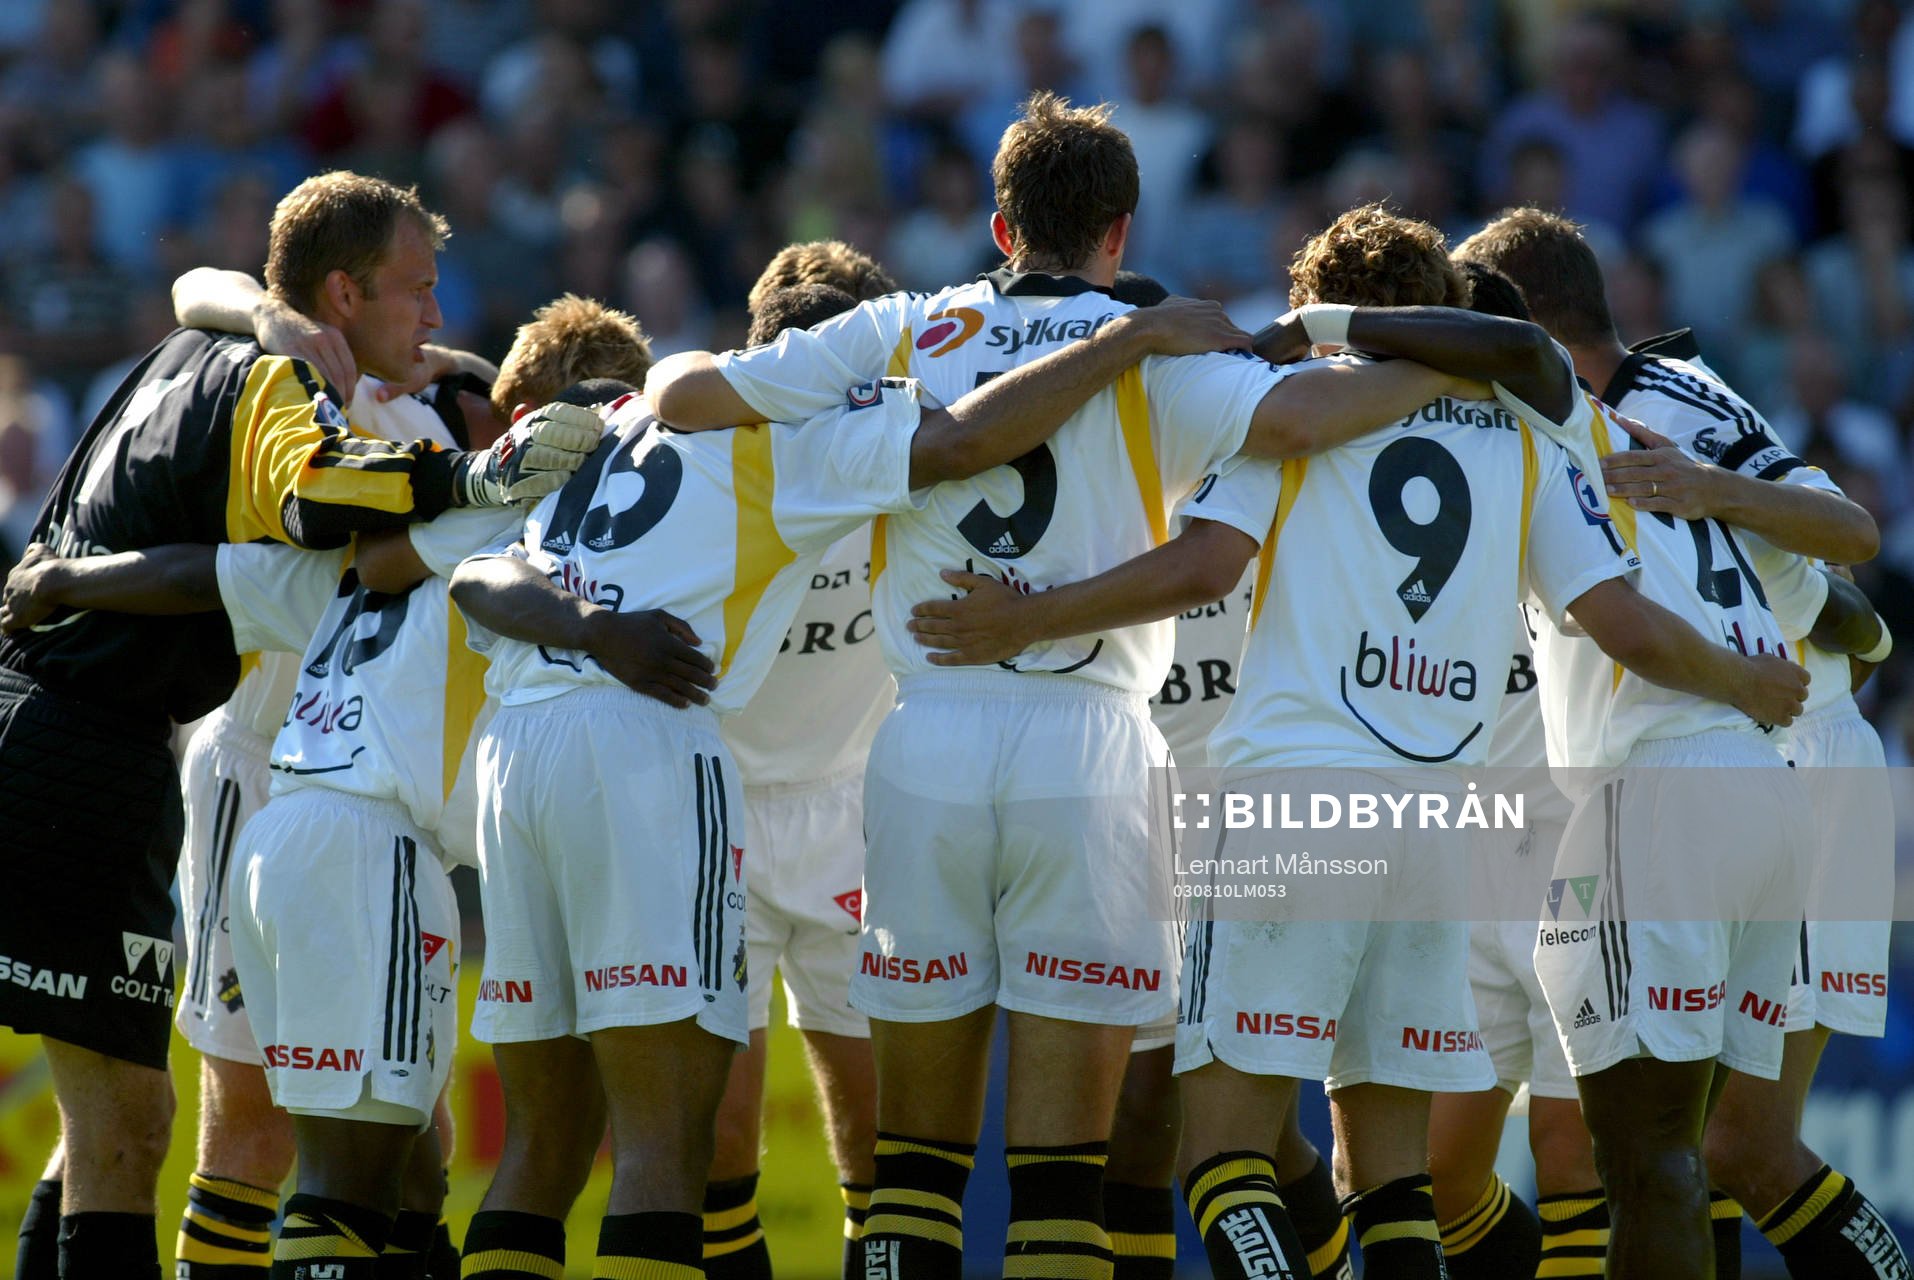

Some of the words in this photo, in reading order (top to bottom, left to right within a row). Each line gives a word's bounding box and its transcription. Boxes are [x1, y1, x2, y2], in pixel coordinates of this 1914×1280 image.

[985, 312, 1115, 355] sydkraf
[1402, 397, 1518, 431] ydkraft
[1749, 448, 1785, 471] KAP
[1368, 436, 1472, 624] 9
[988, 545, 1021, 554] adidas
[1403, 592, 1432, 603] adidas
[1356, 631, 1477, 702] bliwa
[0, 956, 88, 1000] SSAN
[585, 964, 687, 993] NISSAN
[860, 951, 969, 984] NISSAN
[1025, 951, 1160, 992] NISSAN
[1821, 971, 1887, 997] NISS
[111, 975, 161, 1004] COLT
[1648, 979, 1726, 1012] NISSA
[1236, 1011, 1336, 1042] NISSA
[1574, 1015, 1601, 1030] adidas
[1218, 1208, 1281, 1280] STORE
